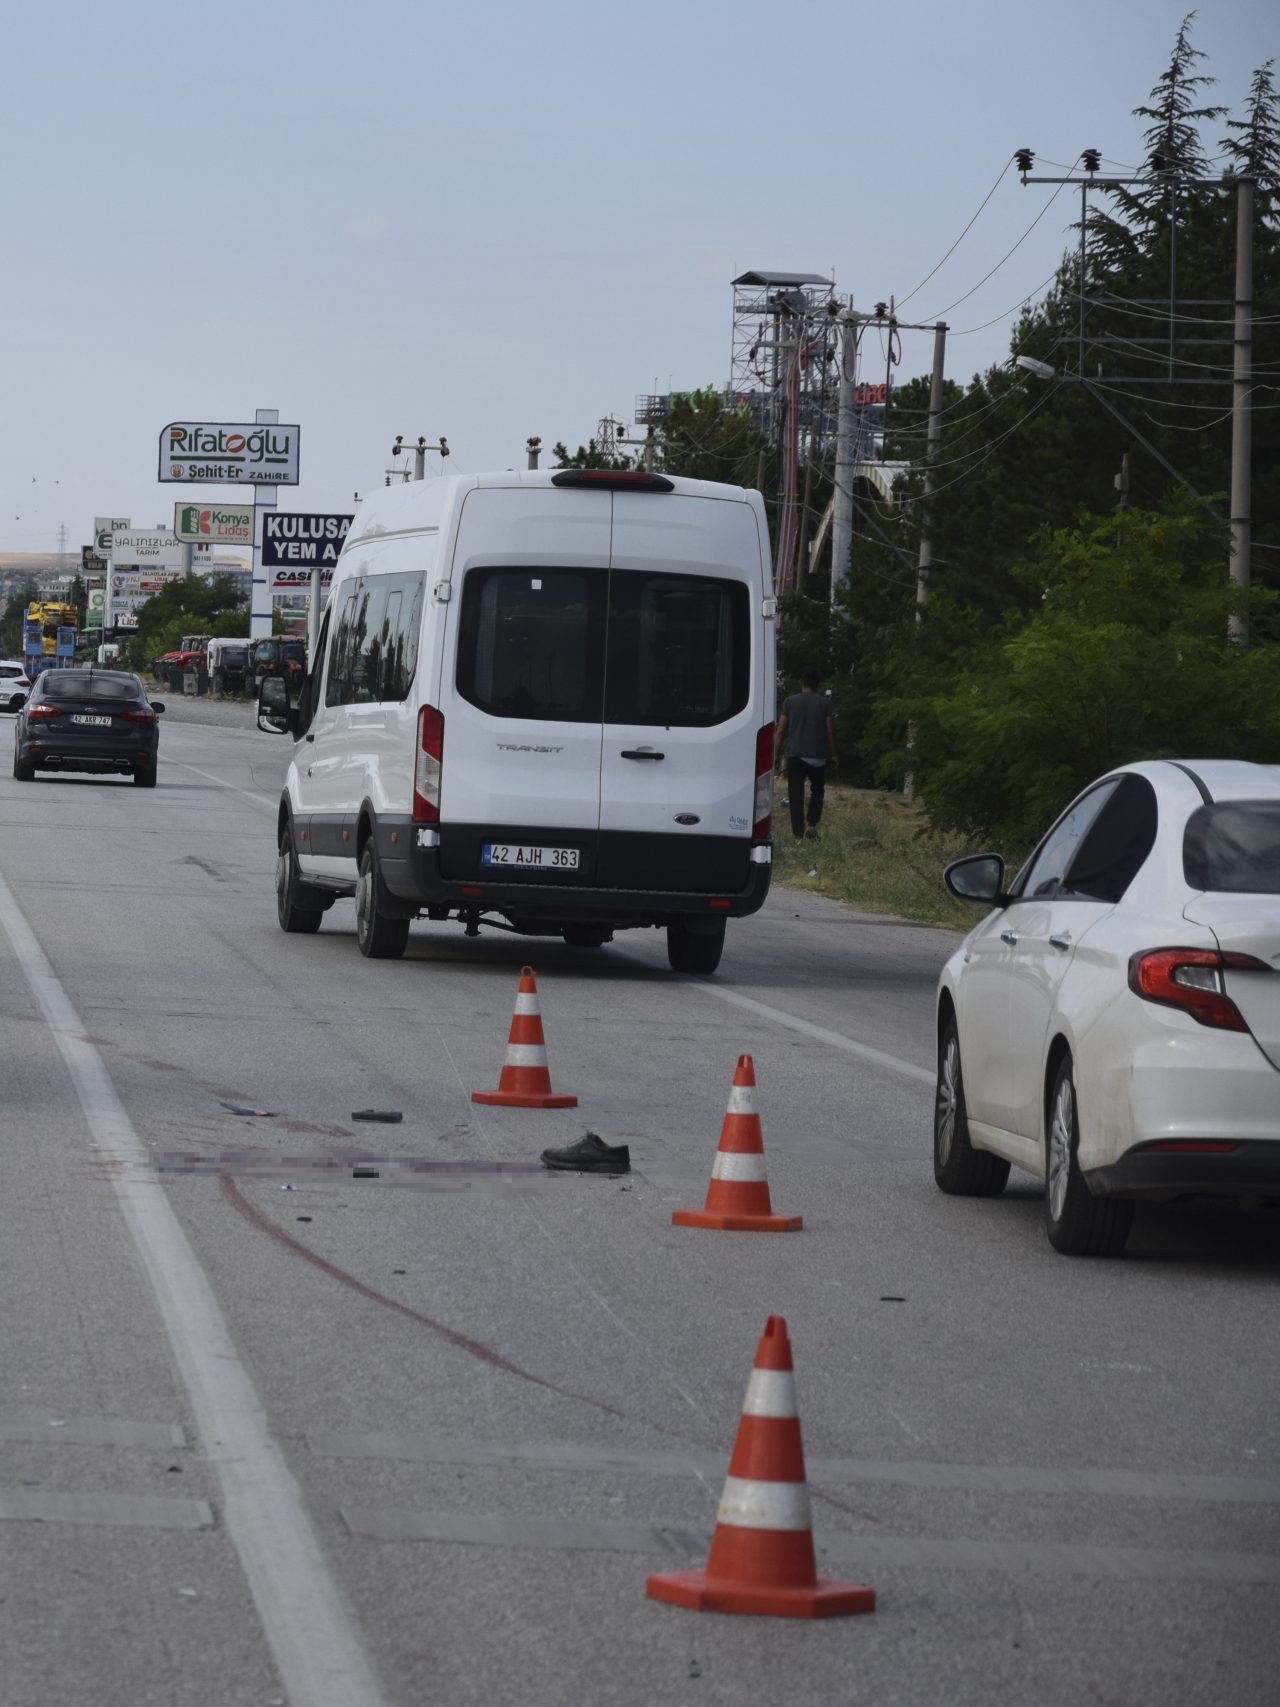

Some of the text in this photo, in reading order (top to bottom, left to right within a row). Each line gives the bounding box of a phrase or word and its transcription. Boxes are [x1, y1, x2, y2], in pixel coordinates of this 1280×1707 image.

[212, 511, 250, 527] Konya
[218, 525, 249, 537] Lidaş
[273, 541, 317, 559] YEM
[496, 743, 564, 753] TRANSIT
[491, 846, 509, 862] 42
[516, 848, 542, 864] AJH
[551, 849, 577, 866] 363
